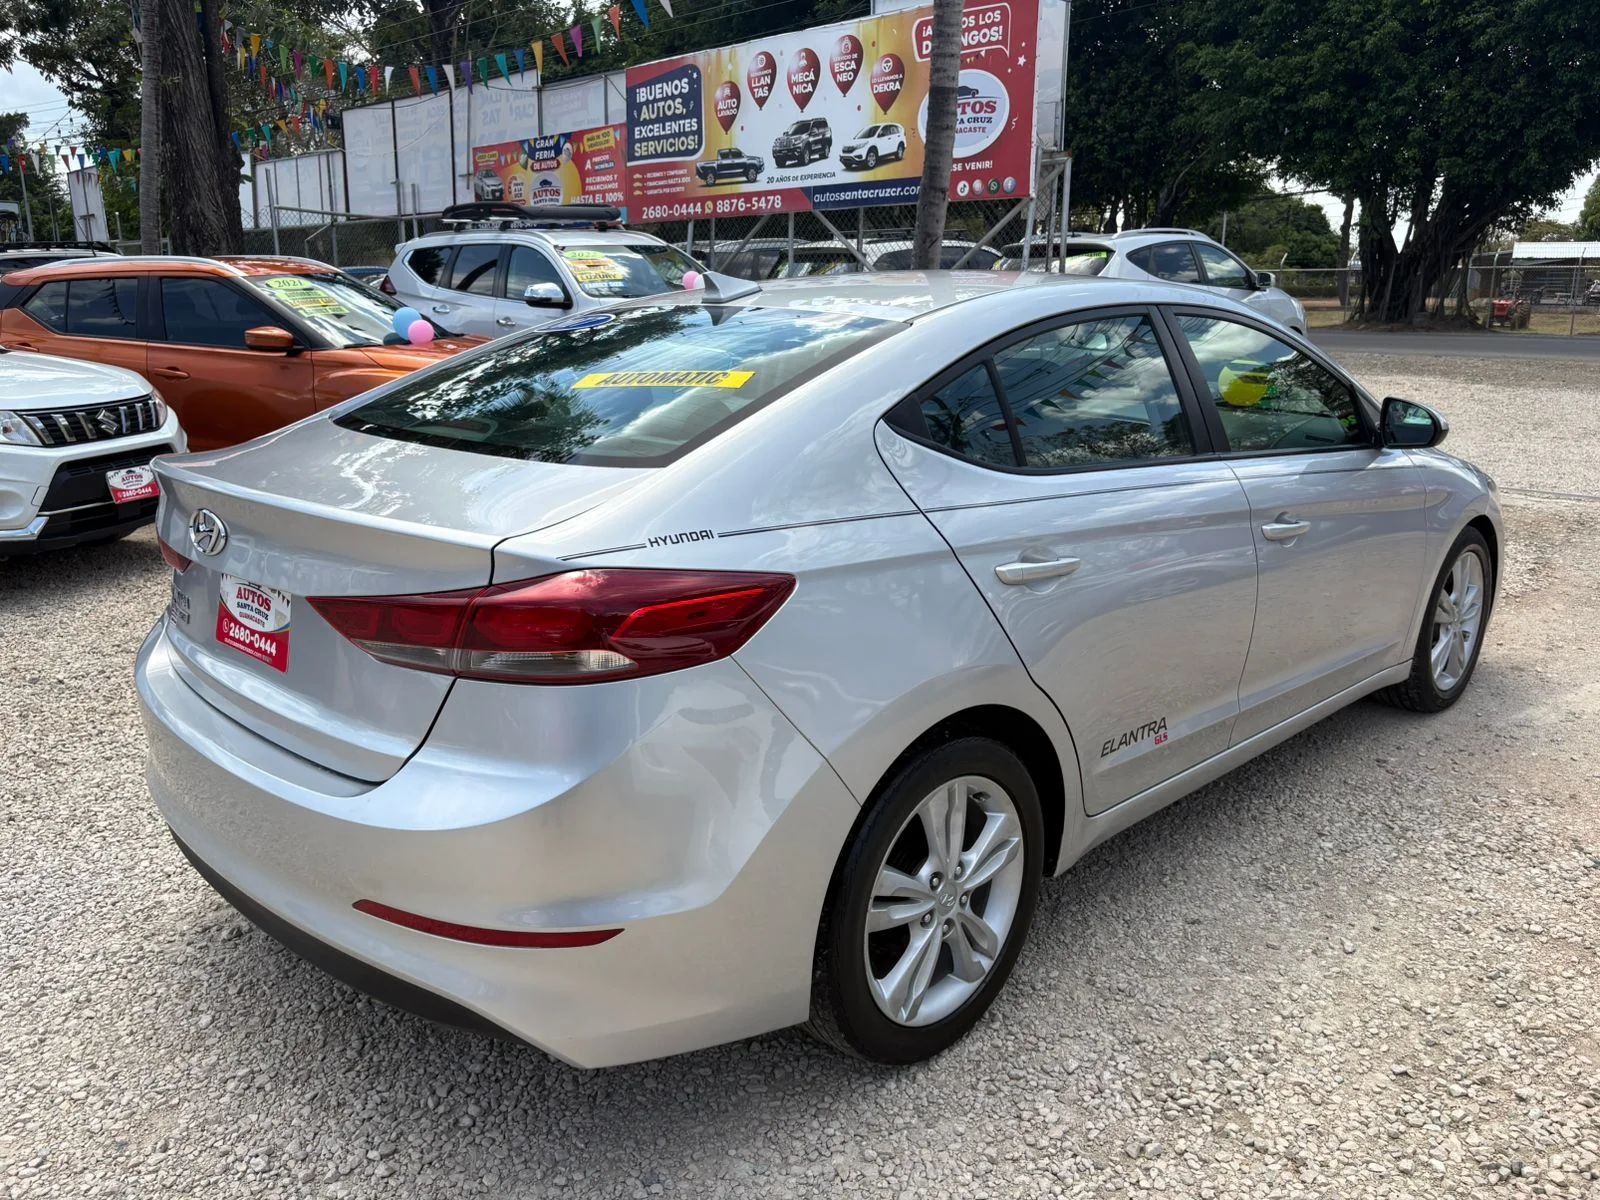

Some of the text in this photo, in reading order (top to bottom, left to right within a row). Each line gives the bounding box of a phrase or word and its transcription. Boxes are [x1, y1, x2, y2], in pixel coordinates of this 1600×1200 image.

[979, 10, 1001, 25] LOS
[834, 60, 856, 72] ESCA
[751, 75, 770, 87] LLAN
[791, 69, 815, 83] MECÁ
[836, 72, 854, 82] NEO
[636, 78, 689, 103] ¡BUENOS
[753, 87, 769, 99] TAS
[792, 83, 813, 95] NICA
[873, 81, 901, 94] DEKRA
[640, 98, 686, 121] AUTOS,
[717, 99, 737, 110] AUTO
[717, 109, 738, 117] LAVADO
[967, 116, 993, 124] CRUZ
[634, 118, 698, 139] EXCELENTES
[536, 139, 554, 149] GRAN
[634, 135, 698, 157] SERVICIOS!
[535, 150, 556, 160] FERIA
[533, 160, 558, 170] DE AUTOS
[585, 159, 592, 170] A
[965, 160, 993, 170] VENIR!
[586, 175, 613, 184] RECIBIMOS
[766, 176, 775, 184] 20
[775, 174, 791, 183] AÑOS
[800, 171, 836, 181] EXPERIENCIA
[585, 183, 618, 192] FINANCIAMOS
[532, 188, 561, 200] AUTOS
[571, 191, 624, 204] HASTA EL 100%
[716, 195, 782, 213] 8876-5478
[642, 202, 702, 219] 2680-0444
[580, 273, 617, 281] LUXURY
[595, 372, 728, 386] AUTOMATIC
[121, 474, 144, 483] AUTOS
[648, 529, 715, 548] HYUNDAI
[236, 586, 272, 612] AUTOS
[236, 601, 269, 621] SANTA CRUZ
[229, 622, 277, 657] 2680-0444
[1100, 716, 1168, 758] ELANTRA
[1154, 732, 1168, 745] GLS
